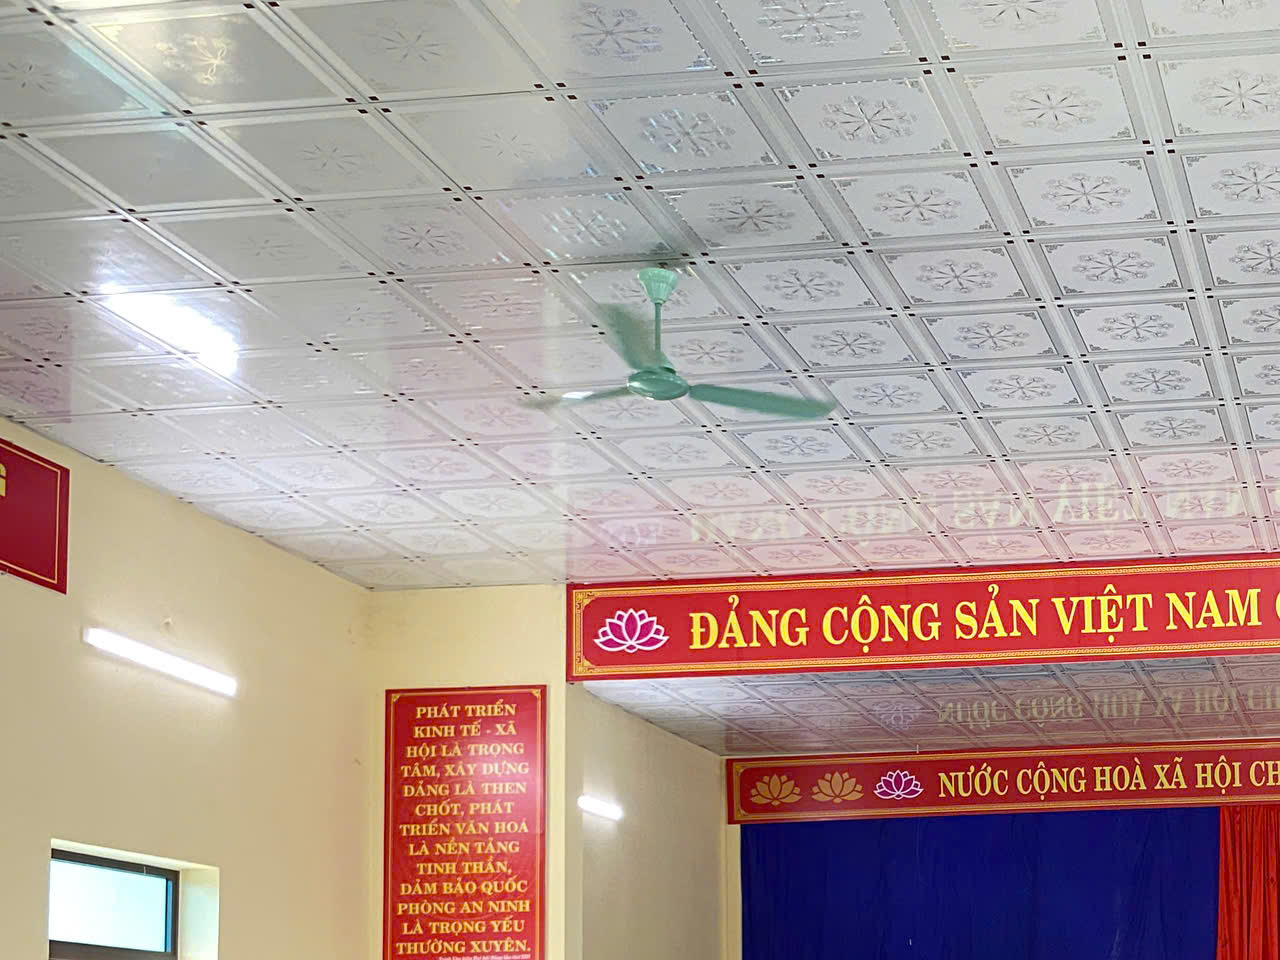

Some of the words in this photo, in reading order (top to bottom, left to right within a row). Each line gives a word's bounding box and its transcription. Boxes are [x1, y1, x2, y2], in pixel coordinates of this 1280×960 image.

[689, 595, 809, 649] ĐẢNG
[823, 595, 941, 653] CỘNG
[956, 584, 1040, 639] SẢN
[1051, 584, 1152, 643] VIỆT
[1165, 589, 1262, 630] NAM
[416, 703, 461, 718] PHÁT
[465, 699, 516, 716] TRIỂN
[414, 725, 455, 738] KINH
[460, 719, 481, 736] TẾ
[495, 720, 517, 735] XÃ
[407, 743, 436, 760] HỘI
[441, 742, 463, 757] LÀ
[468, 743, 524, 759] TRỌNG
[401, 762, 440, 778] TÂM,
[445, 760, 479, 778] XÂY
[482, 760, 529, 777] DỰNG
[938, 763, 1008, 797] NƯỚC
[1017, 761, 1086, 799] CỘNG
[1093, 758, 1147, 791] HOÀ
[1154, 757, 1187, 789] XÃ
[1198, 755, 1242, 794] HỘI
[404, 780, 451, 797] ĐẢNG
[454, 779, 477, 795] LÀ
[482, 782, 527, 794] THEN
[415, 798, 466, 818] CHỐT,
[470, 799, 515, 814] PHÁT
[455, 820, 490, 834] VĂN
[494, 818, 528, 833] HOÁ
[409, 840, 430, 856] LÀ
[474, 837, 520, 853] TẢNG
[417, 862, 457, 874] TINH
[442, 877, 477, 894] BẢO
[479, 875, 528, 895] QUỐC
[397, 900, 456, 915] PHÒNG
[460, 901, 486, 913] AN
[488, 900, 530, 912] NINH
[402, 919, 423, 935] LÀ
[429, 921, 486, 936] TRỌNG
[490, 915, 524, 932] YẾU
[396, 939, 466, 954] THƯỜNG
[470, 937, 531, 952] XUYÊN.
